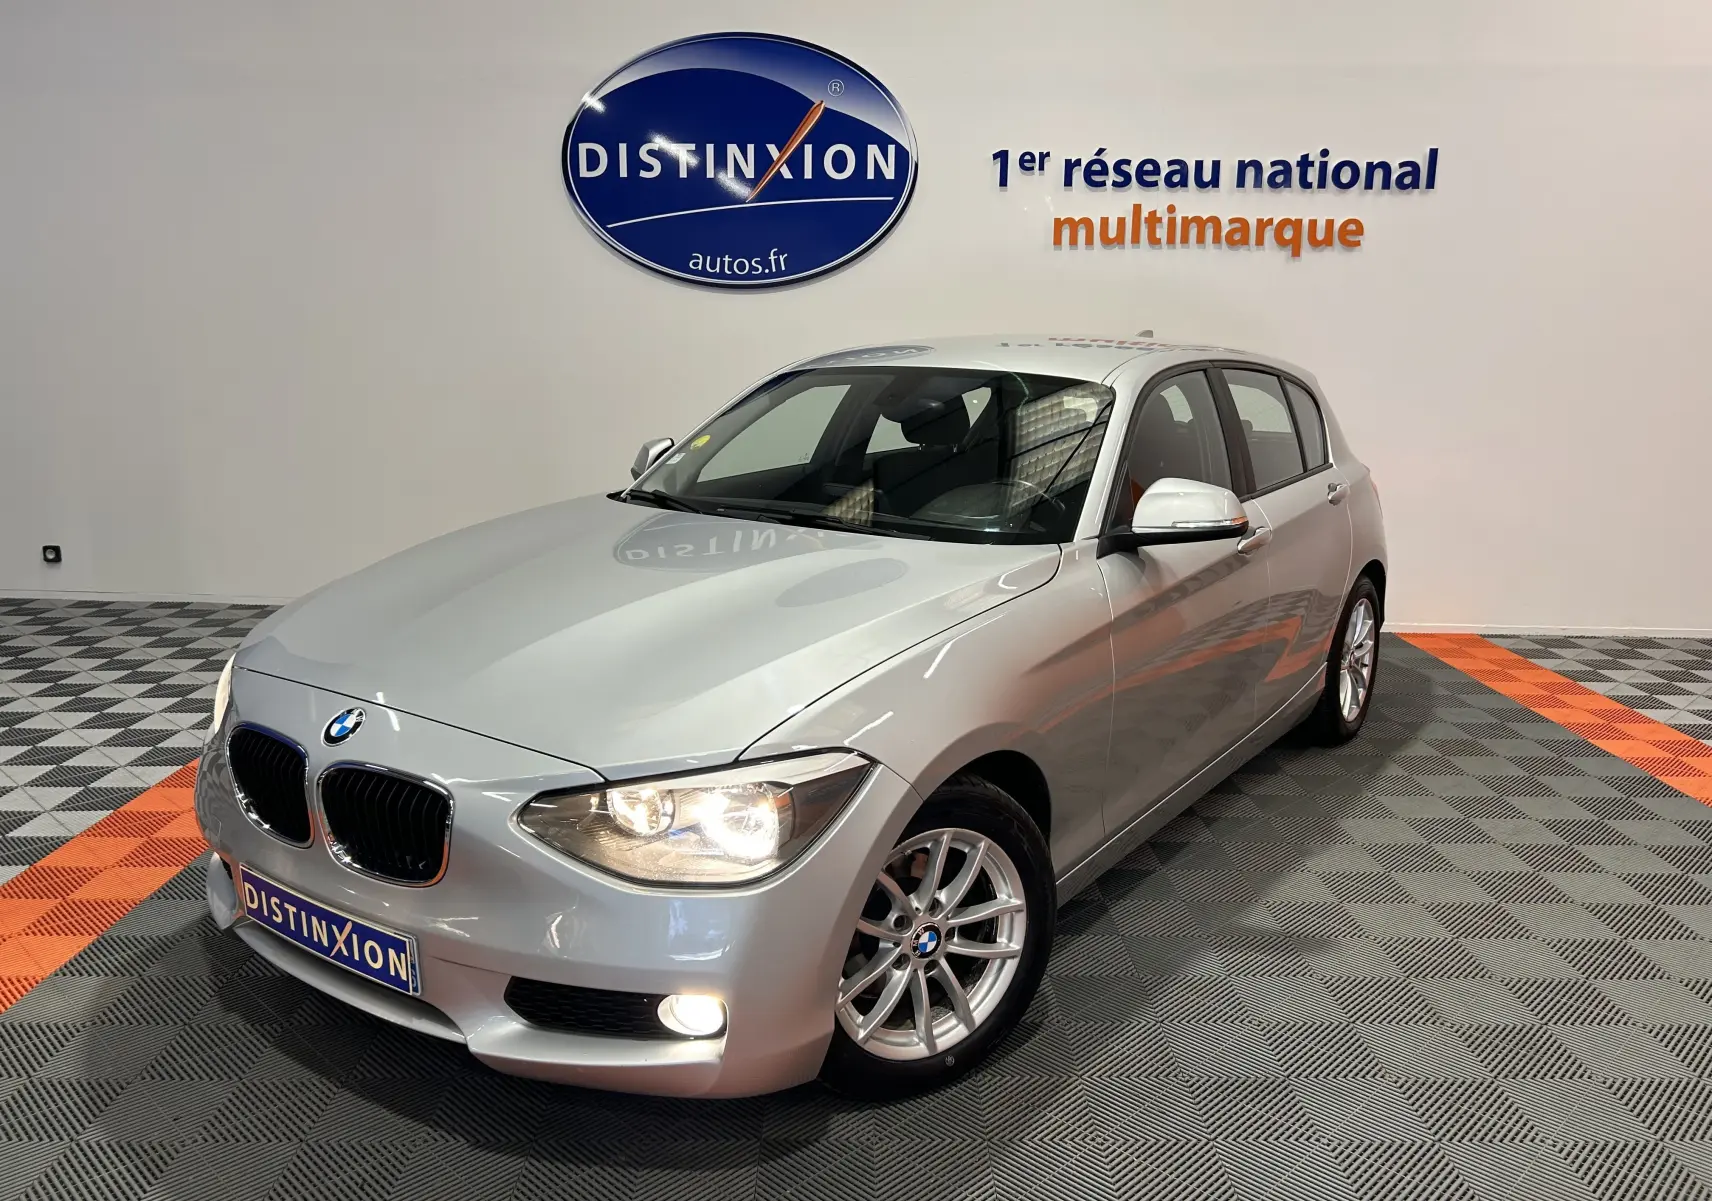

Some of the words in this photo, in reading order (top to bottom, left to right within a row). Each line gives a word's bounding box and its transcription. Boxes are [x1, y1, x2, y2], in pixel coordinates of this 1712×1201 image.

[991, 148, 1051, 188] 1er
[1062, 147, 1222, 190] réseau
[1235, 147, 1439, 191] national
[1052, 203, 1365, 258] multimarque
[688, 248, 789, 275] autos.fr
[243, 881, 408, 982] DISTINXION
